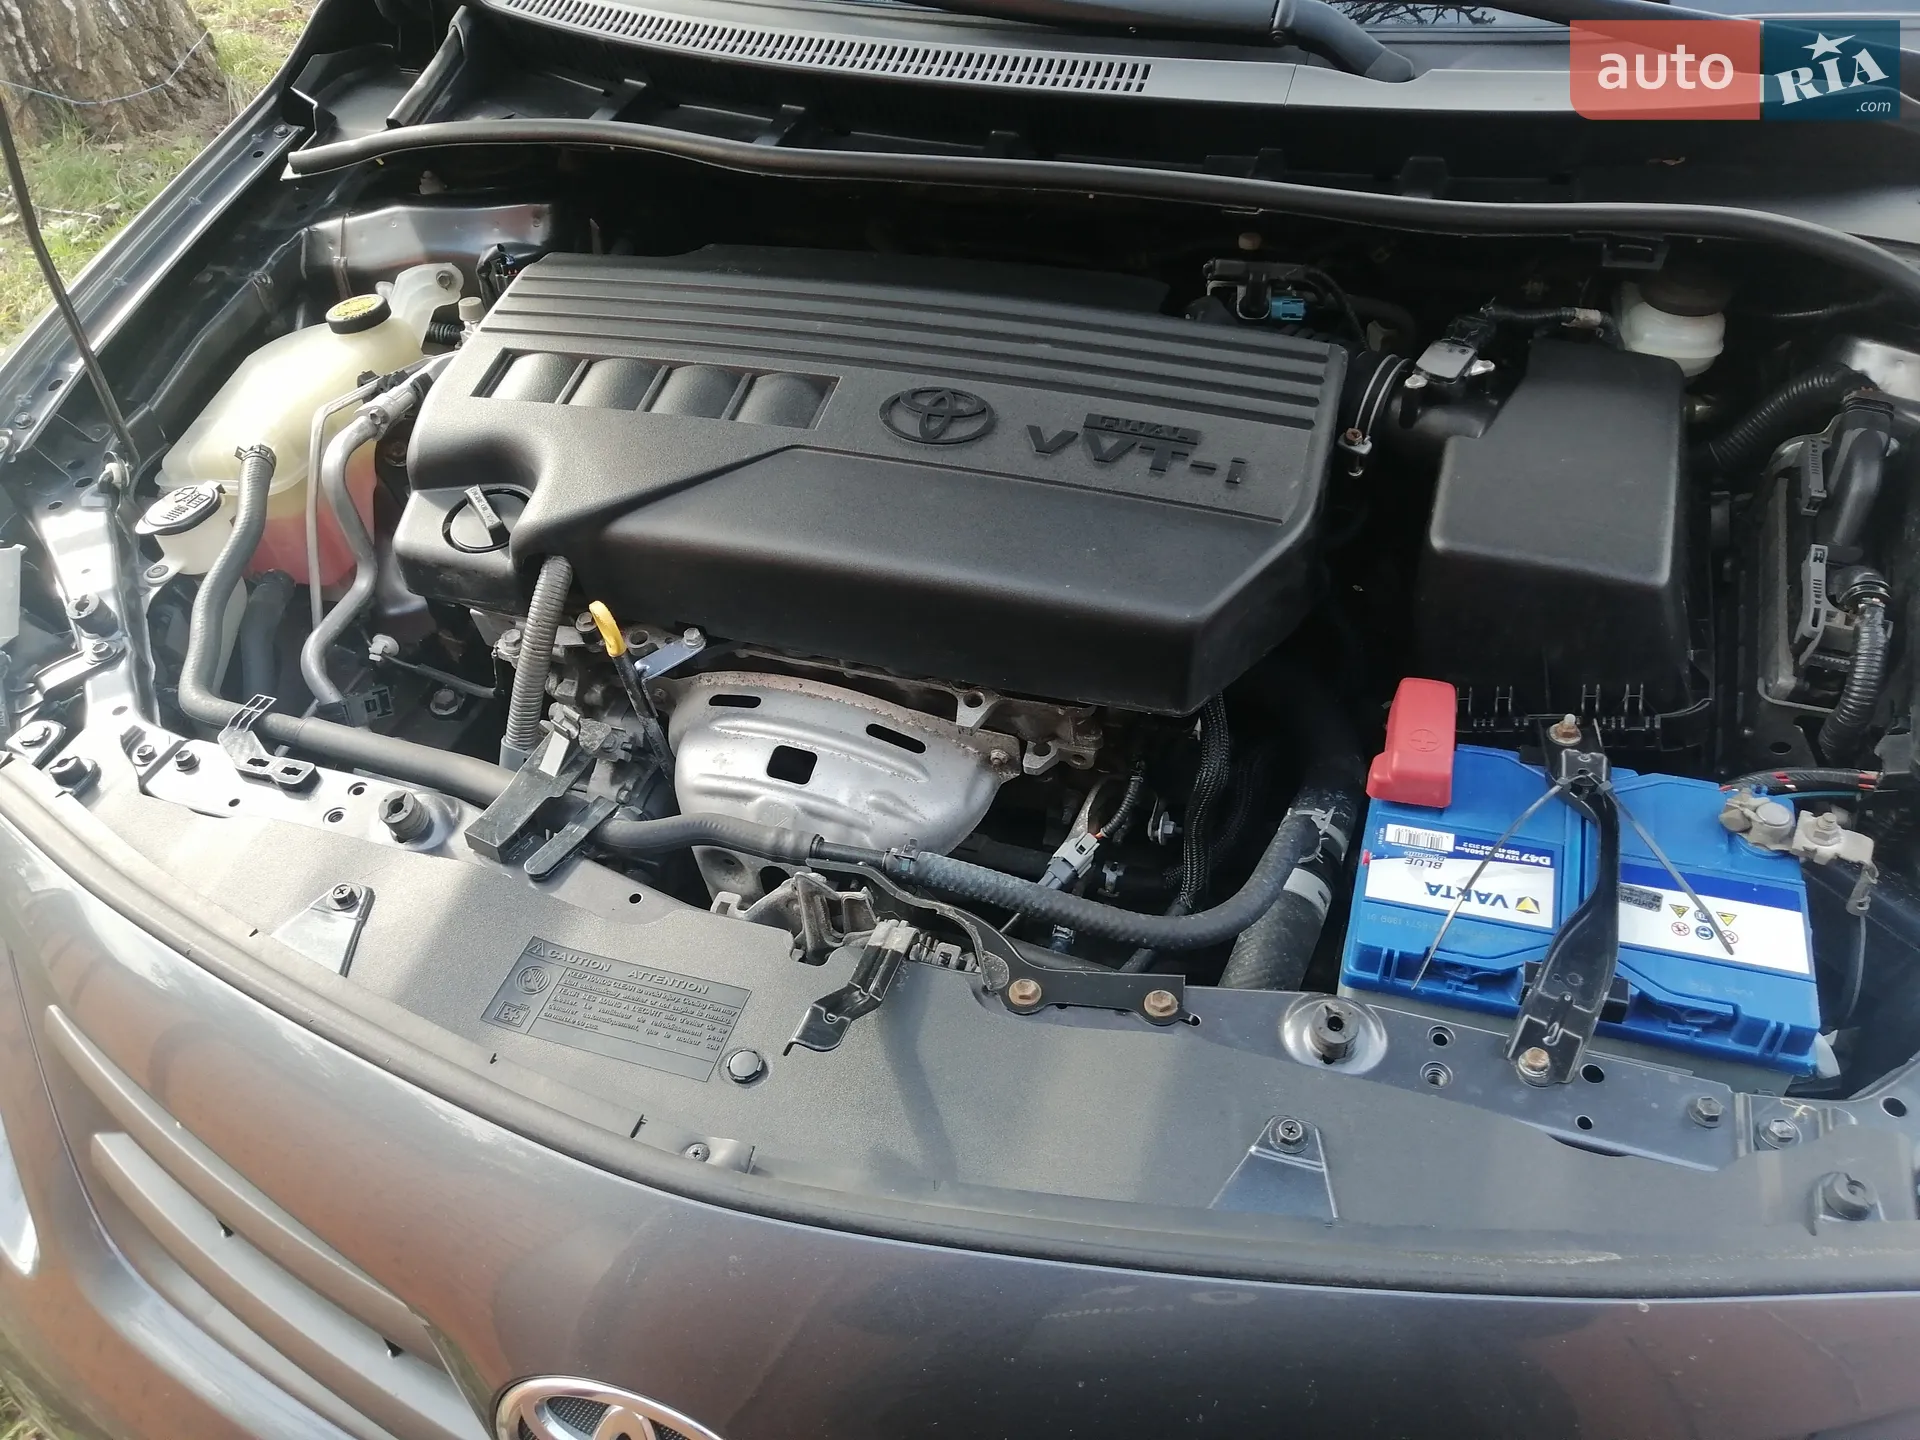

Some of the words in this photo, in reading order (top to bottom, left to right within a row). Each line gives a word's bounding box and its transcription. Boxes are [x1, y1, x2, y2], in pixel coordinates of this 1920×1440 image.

[1404, 857, 1444, 870] BLUE
[1504, 854, 1521, 862] 12V
[1521, 853, 1551, 866] D47
[1425, 881, 1510, 909] VARTA
[548, 949, 612, 972] CAUTION
[628, 969, 710, 995] ATTENTION
[567, 970, 587, 981] KEEP
[586, 973, 612, 986] HANDS
[612, 980, 636, 994] CLEAR
[682, 996, 708, 1011] Cooling
